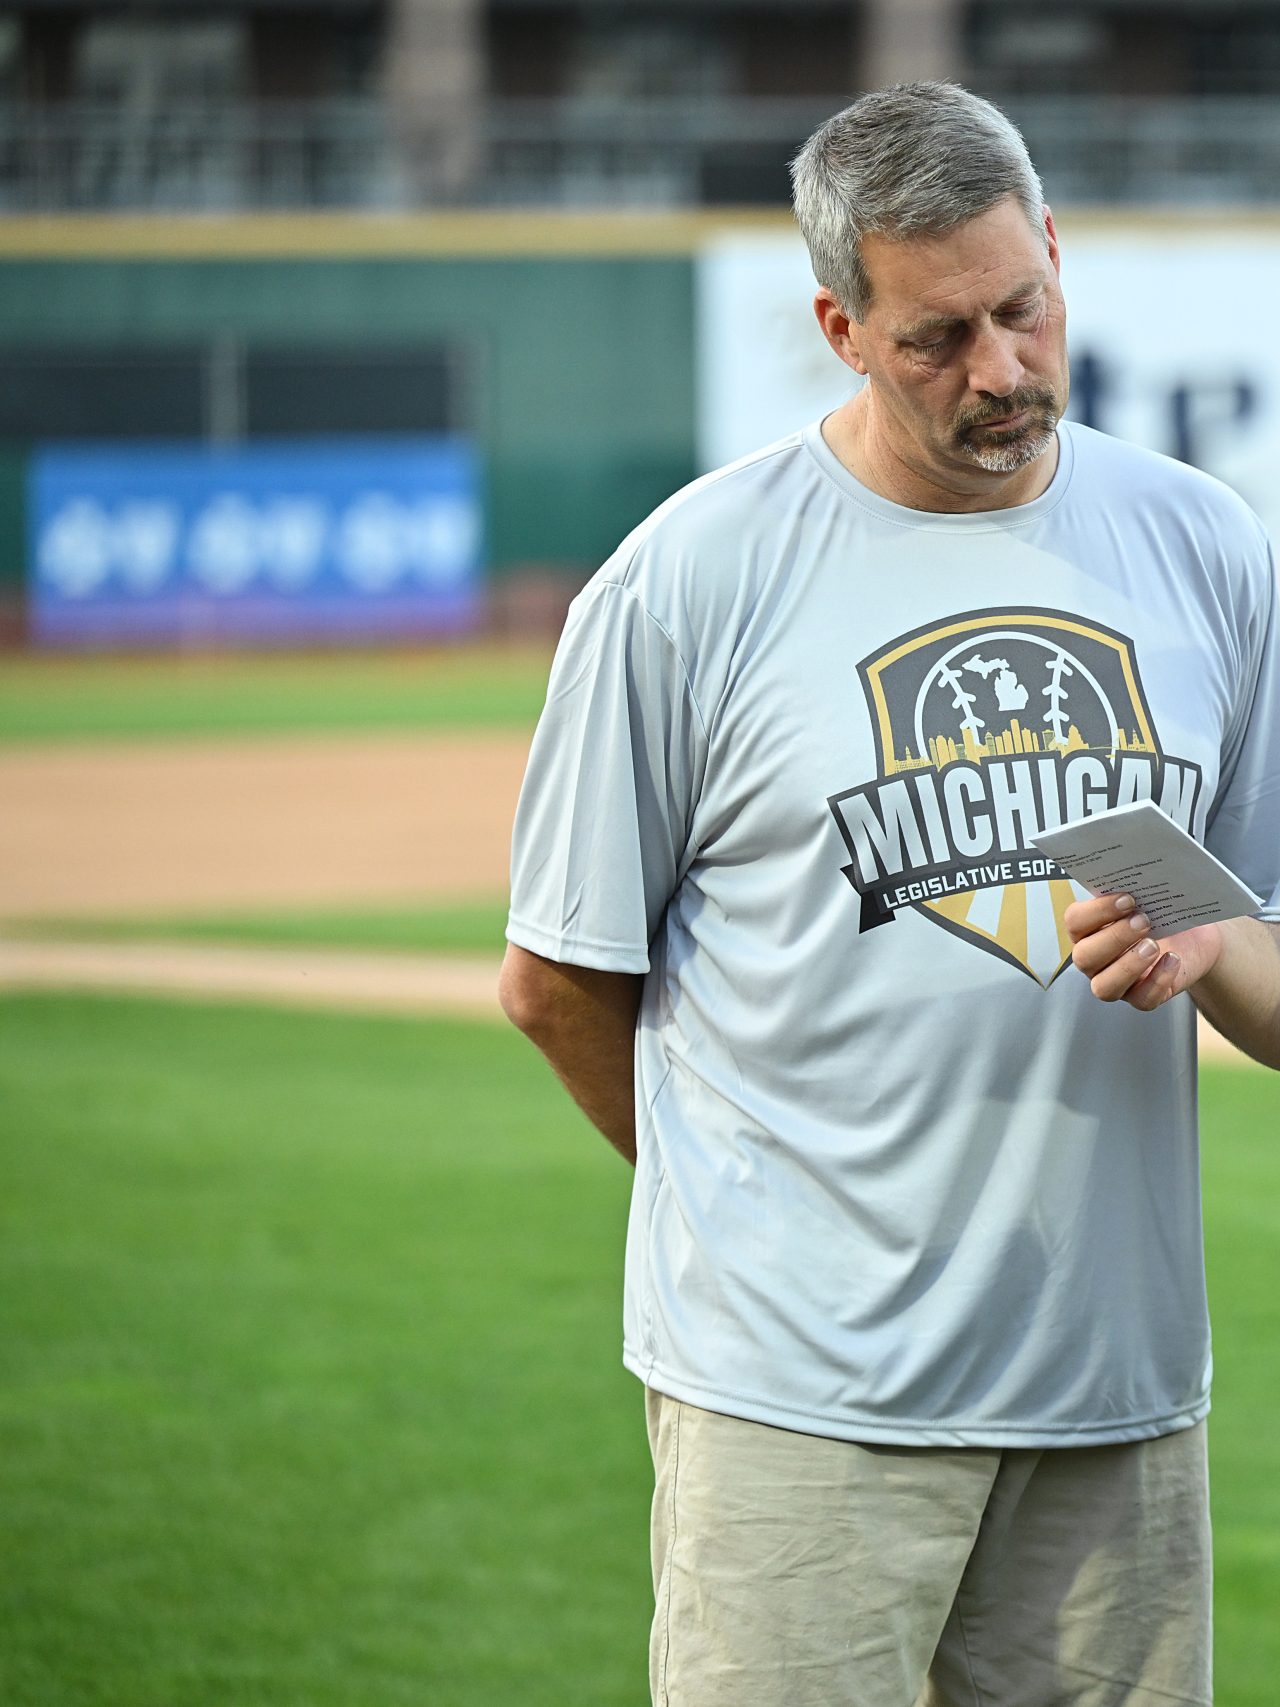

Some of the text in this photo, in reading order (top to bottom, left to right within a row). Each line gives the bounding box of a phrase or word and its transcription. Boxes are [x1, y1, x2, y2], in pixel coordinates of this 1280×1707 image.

[836, 756, 1198, 885] MICHIGAN
[882, 862, 1014, 909] LEGISLATIVE
[1018, 859, 1066, 878] SOF
